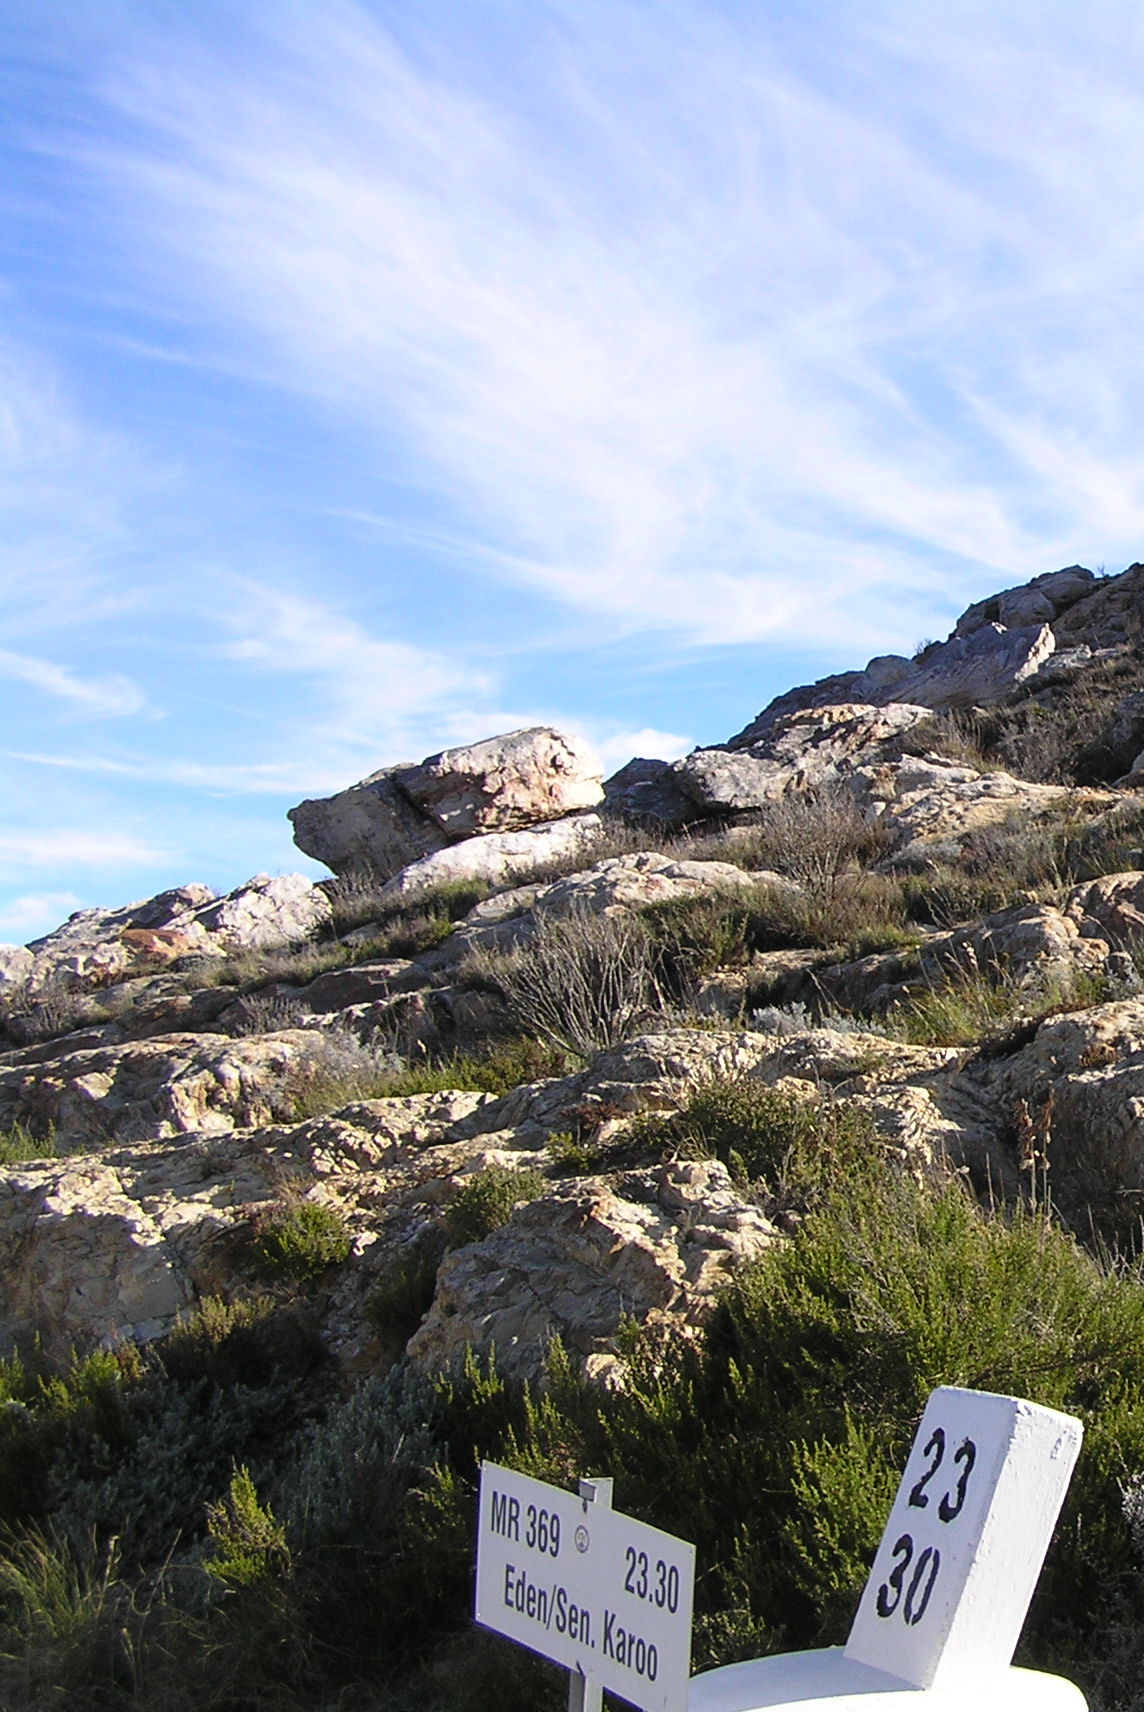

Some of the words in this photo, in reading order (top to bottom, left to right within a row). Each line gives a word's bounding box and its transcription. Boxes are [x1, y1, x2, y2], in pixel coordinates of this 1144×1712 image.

[908, 1427, 976, 1523] 23
[491, 1490, 520, 1541] MR
[526, 1504, 561, 1558] 369
[504, 1563, 595, 1649] Eden/Sen.
[603, 1609, 658, 1682] Karoo
[625, 1546, 680, 1614] 23.30
[876, 1533, 941, 1626] 30
